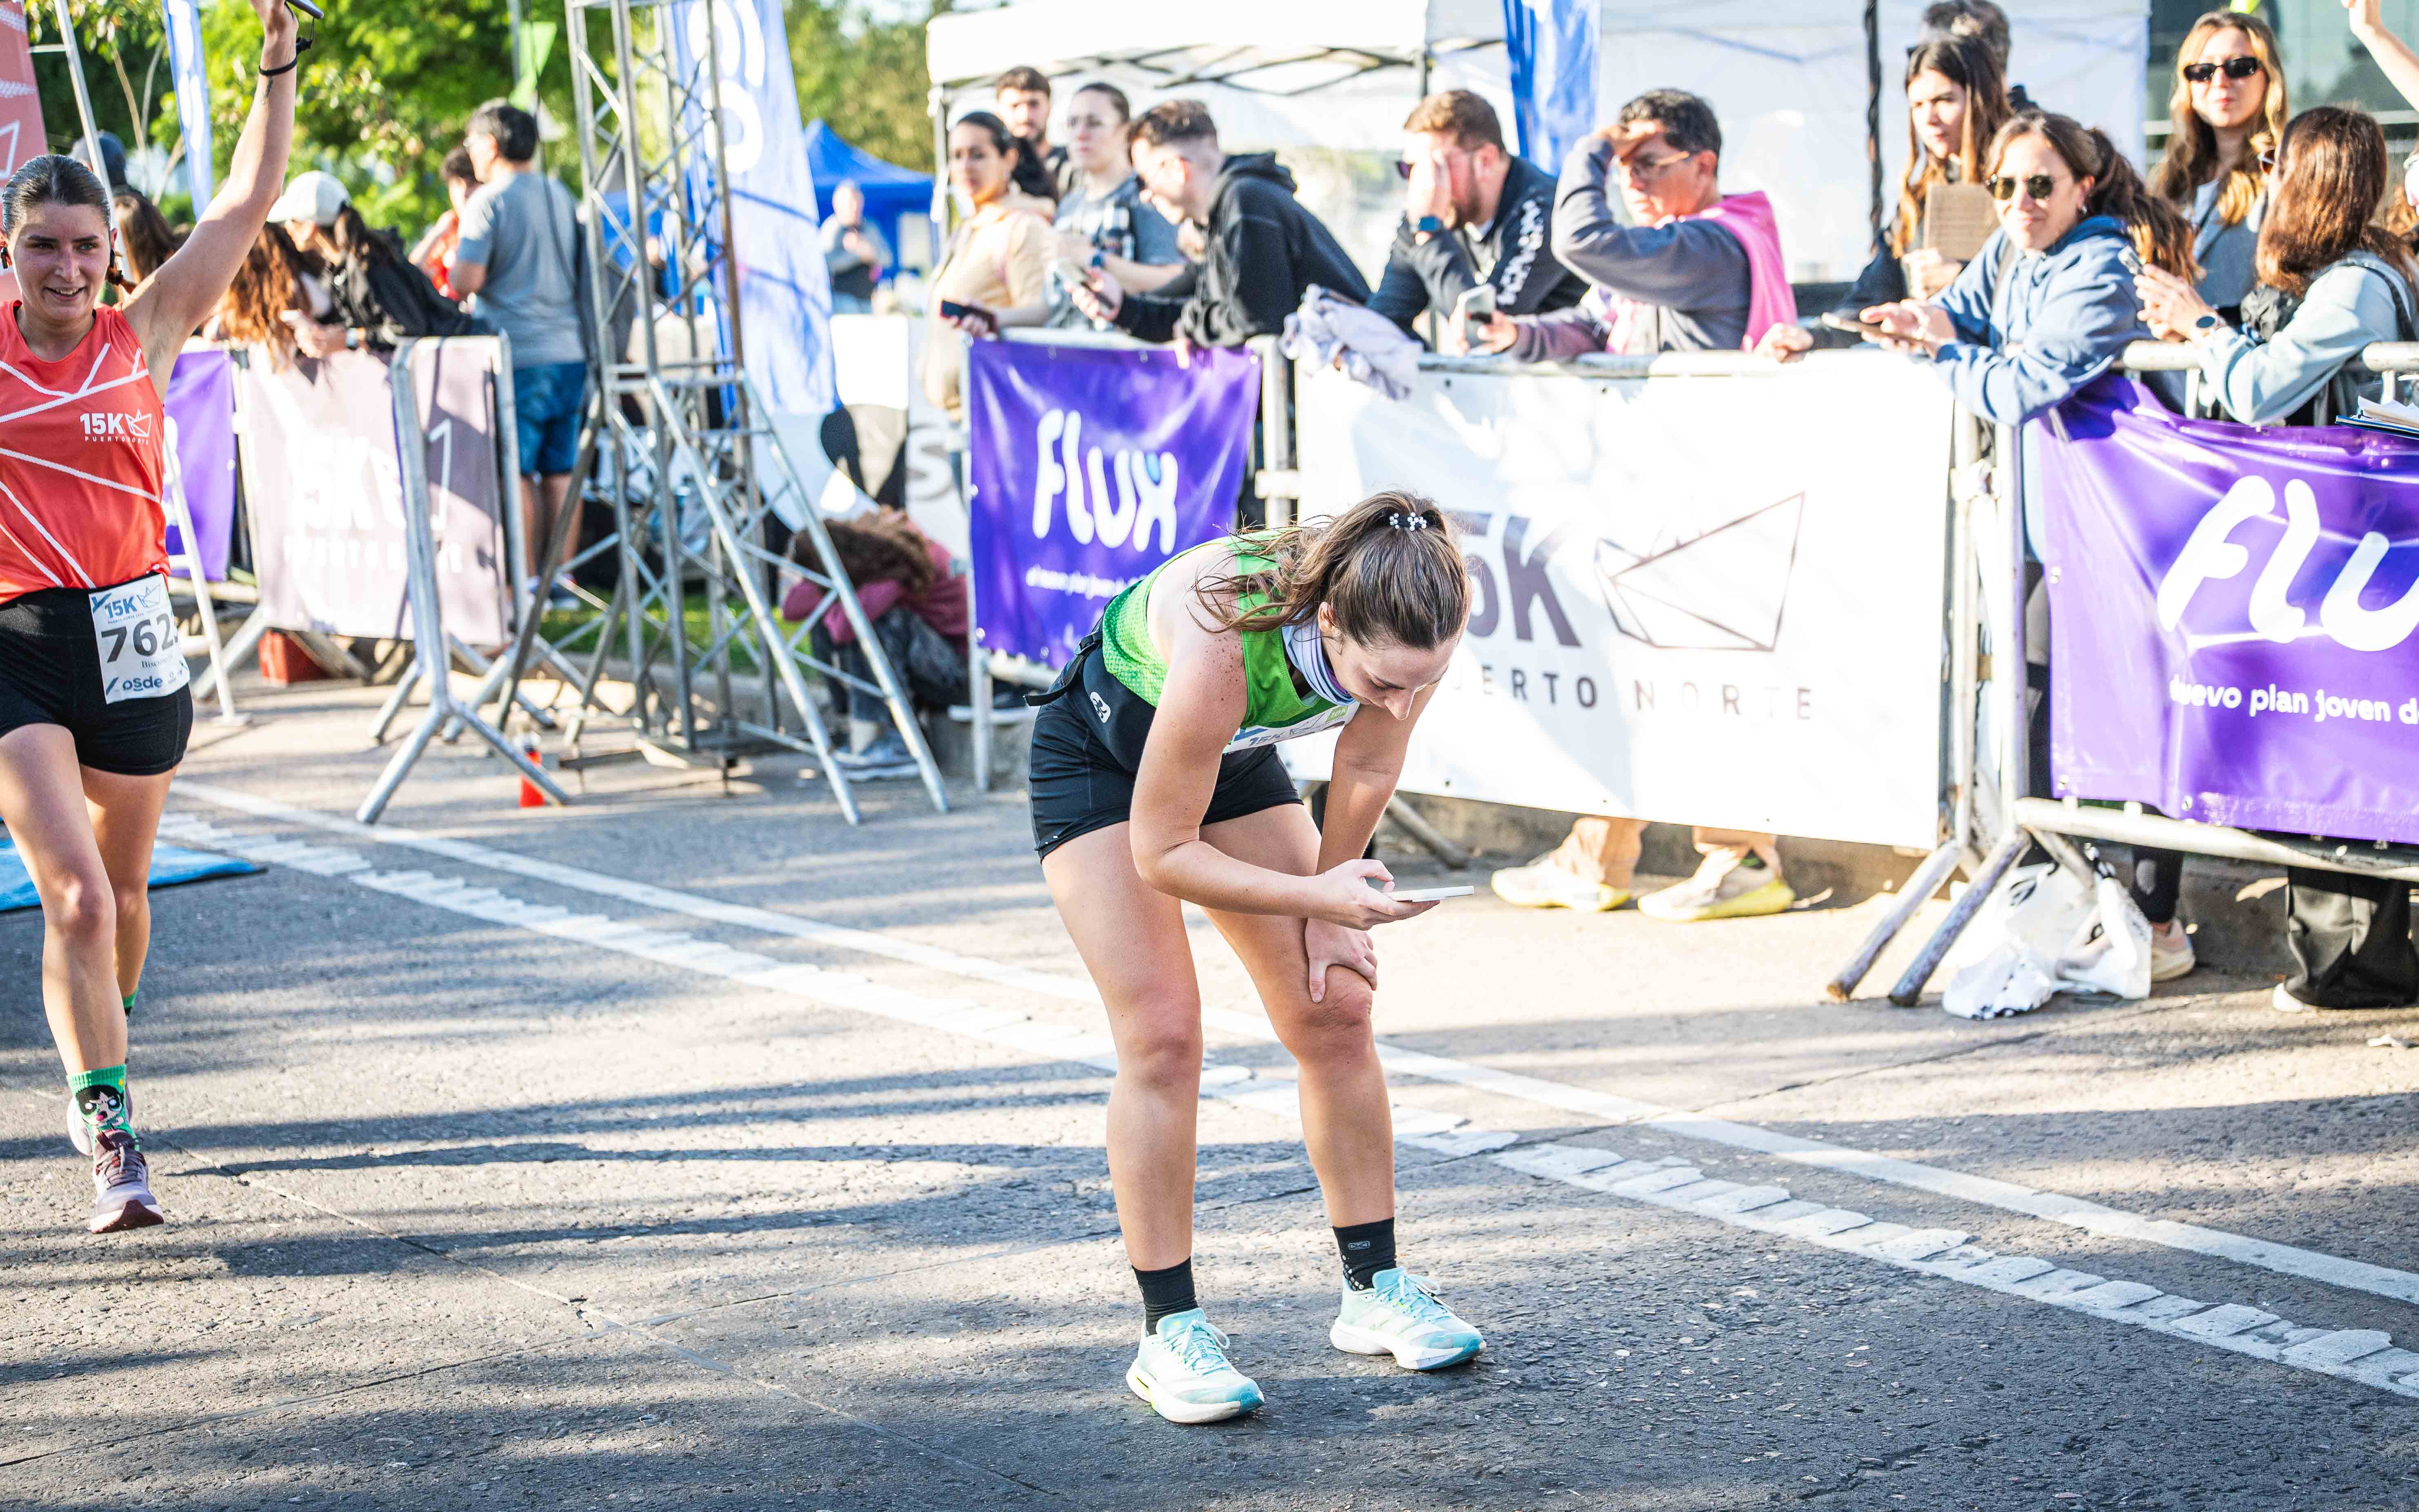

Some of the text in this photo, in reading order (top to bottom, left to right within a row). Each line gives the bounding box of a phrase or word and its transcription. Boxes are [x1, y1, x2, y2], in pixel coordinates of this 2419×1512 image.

[80, 413, 124, 435] 15K
[1445, 511, 1582, 647] 5K
[104, 596, 138, 619] 15K
[101, 613, 178, 664] 762
[122, 675, 163, 691] osde
[1451, 664, 1597, 708] UERTO
[2249, 684, 2308, 717] plan
[2315, 689, 2391, 722] joven
[2399, 698, 2419, 724] d
